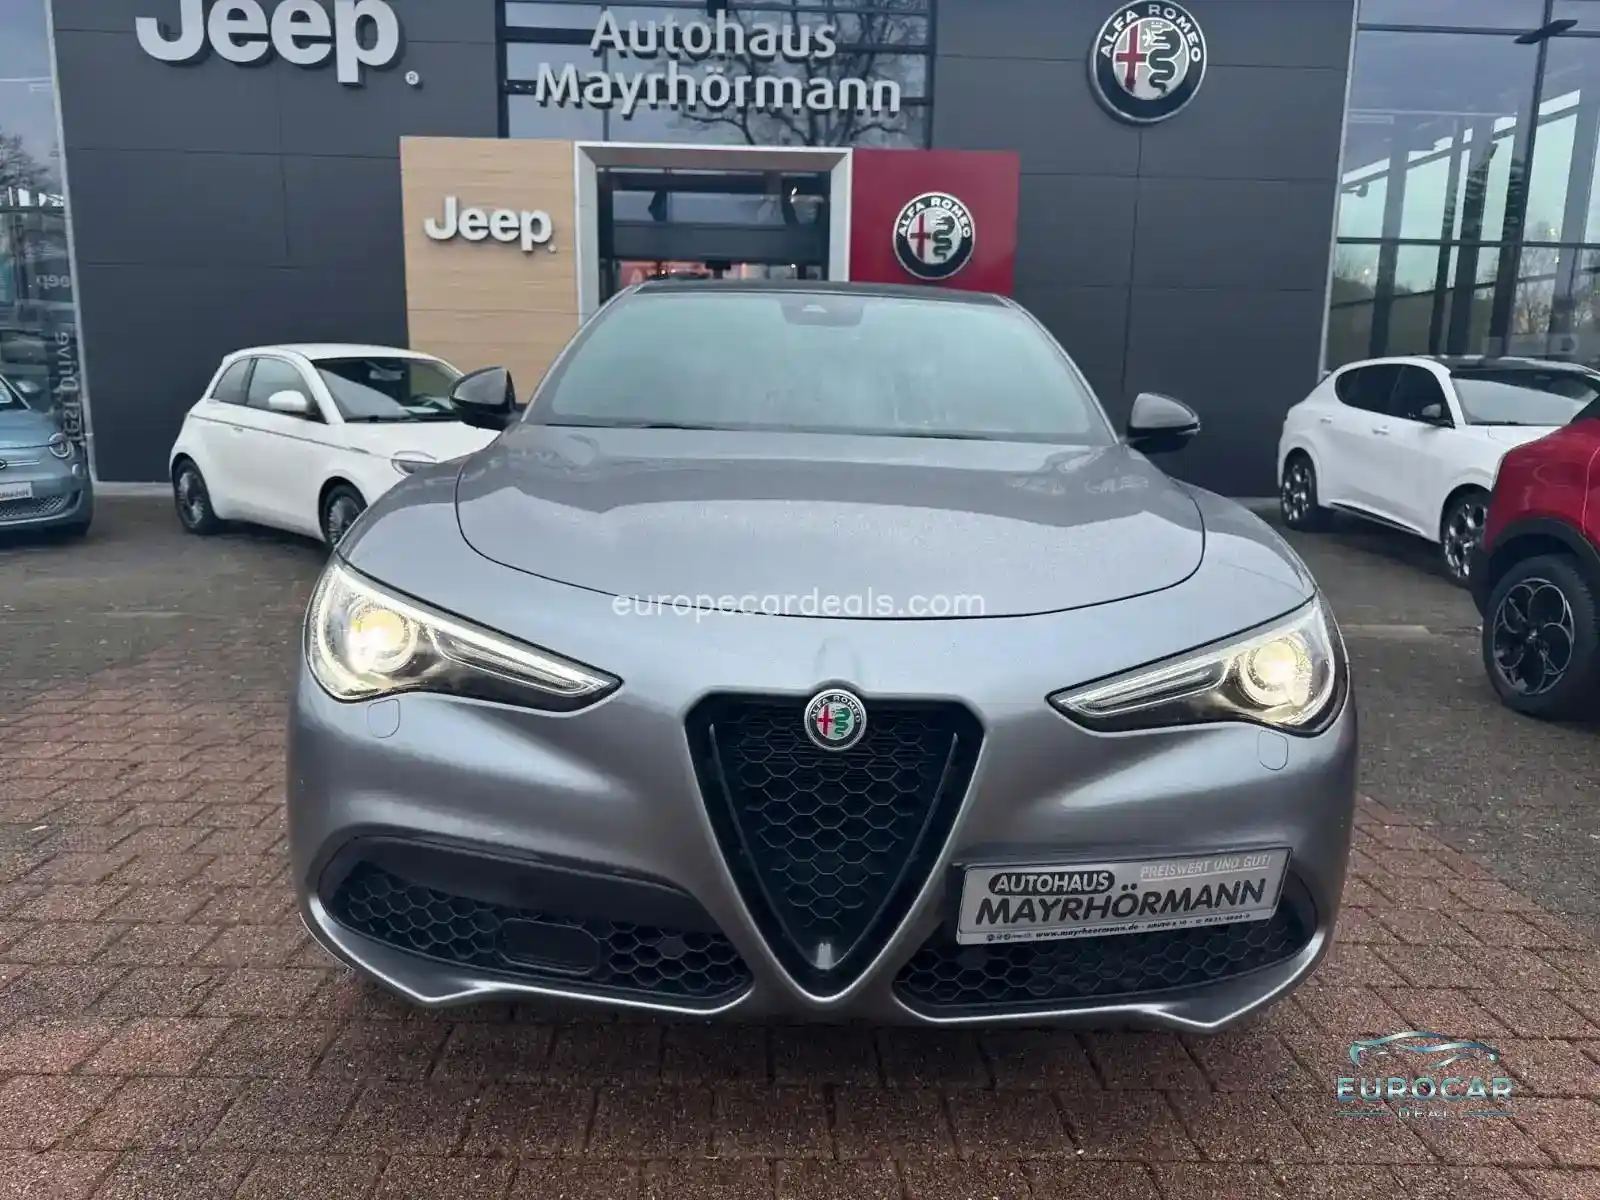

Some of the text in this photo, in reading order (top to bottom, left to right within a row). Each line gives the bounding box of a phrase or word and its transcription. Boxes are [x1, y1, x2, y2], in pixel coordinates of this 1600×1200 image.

[135, 0, 399, 82] Jeep
[590, 7, 837, 59] Autohaus
[1100, 4, 1202, 62] ALFA ROMEO
[535, 60, 901, 116] Mayrhörmann
[423, 195, 553, 252] Jeep
[898, 196, 971, 239] ALFA ROMEO
[811, 695, 861, 723] ALFA ROMEO
[994, 872, 1110, 893] AUTOHAUS
[1140, 859, 1210, 878] PREISWERT
[1213, 855, 1239, 871] UND
[975, 878, 1267, 926] MAYRHÖRMANN
